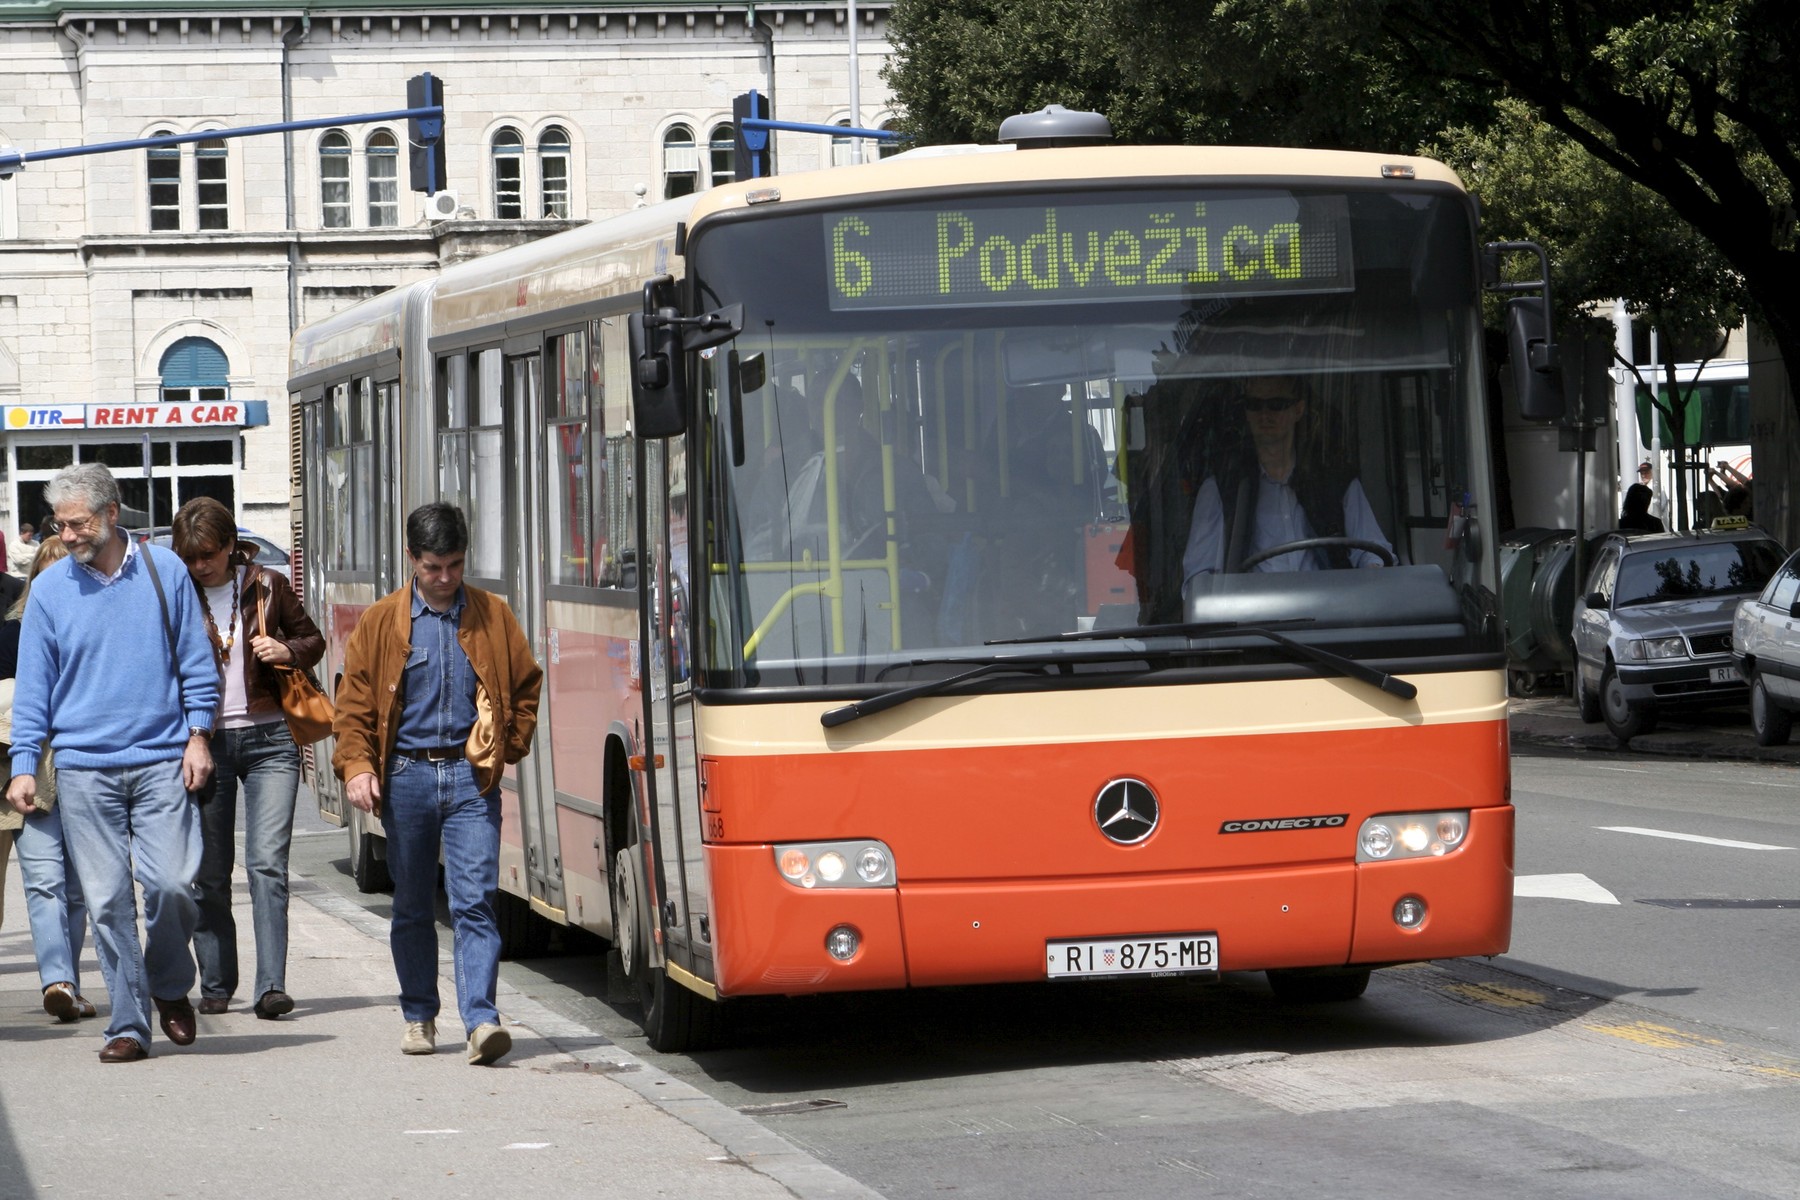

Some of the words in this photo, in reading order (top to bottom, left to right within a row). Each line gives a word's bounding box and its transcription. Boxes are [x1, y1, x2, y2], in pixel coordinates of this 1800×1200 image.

[833, 216, 872, 298] 6
[937, 201, 1302, 294] Podvežica
[29, 409, 63, 425] ITR
[94, 407, 159, 425] RENT
[165, 406, 183, 424] A
[191, 405, 239, 423] CAR
[1717, 516, 1745, 525] TAXI
[1718, 668, 1731, 680] RI
[1224, 816, 1345, 832] CONECTO
[1066, 946, 1094, 971] RI
[1120, 940, 1212, 970] 875-MB
